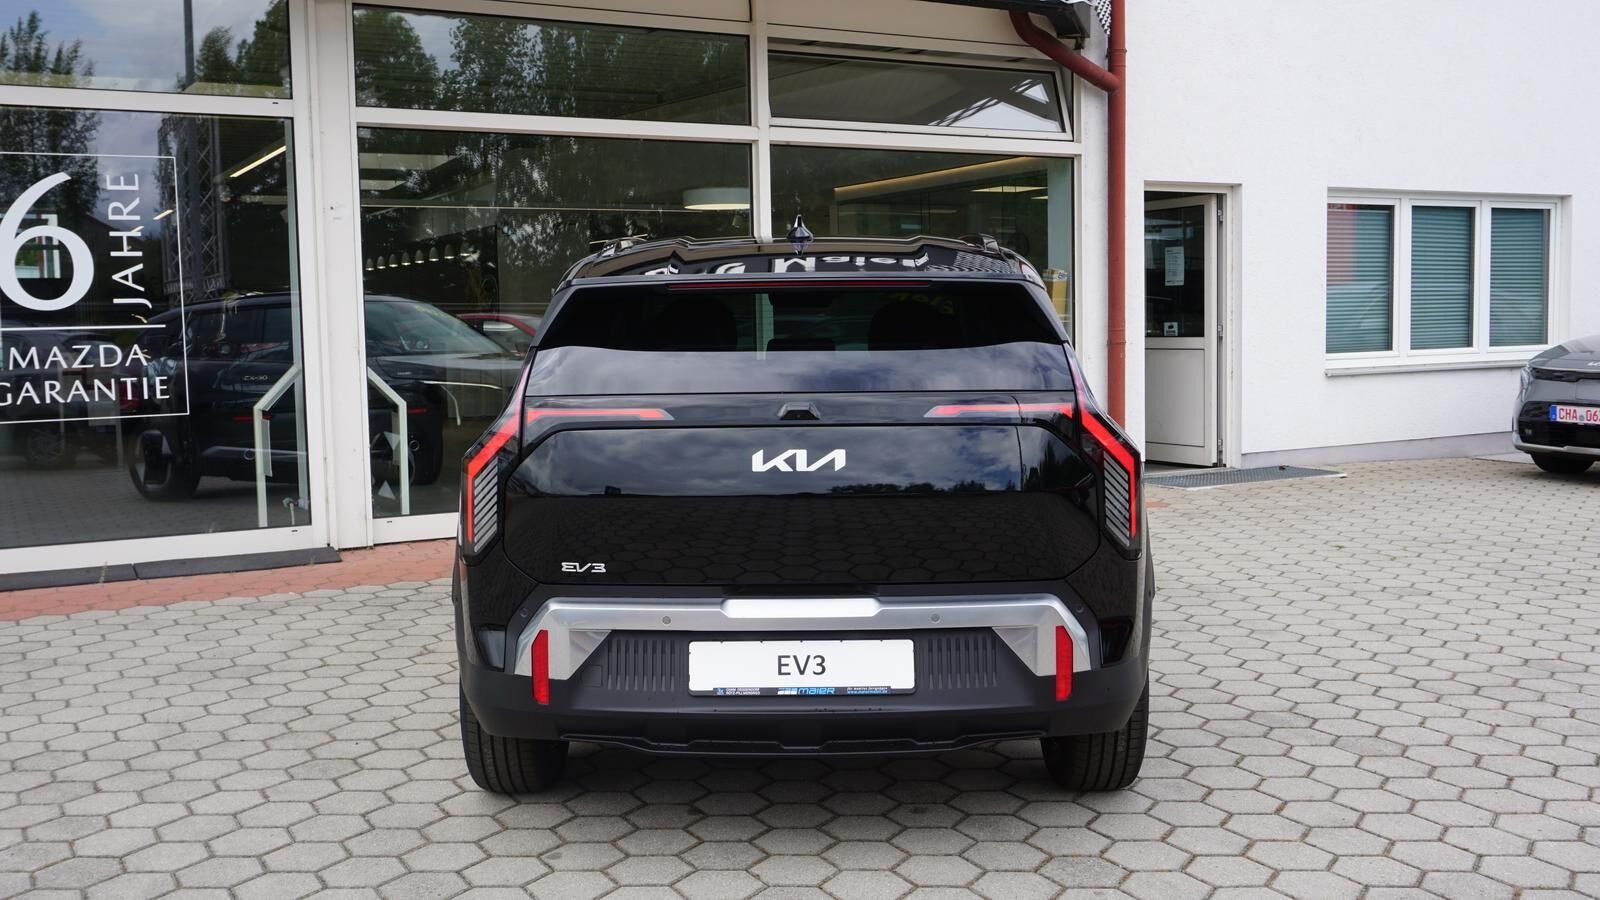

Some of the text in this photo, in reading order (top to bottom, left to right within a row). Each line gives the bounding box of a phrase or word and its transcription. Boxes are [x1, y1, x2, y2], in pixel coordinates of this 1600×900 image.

[0, 172, 94, 311] 6
[106, 173, 152, 309] JAHRE
[9, 343, 148, 371] MAZDA
[0, 376, 170, 406] GARANTIE
[1558, 407, 1600, 422] CHA 06
[752, 449, 846, 472] KIA
[561, 562, 606, 573] EV3
[777, 655, 827, 676] EV3
